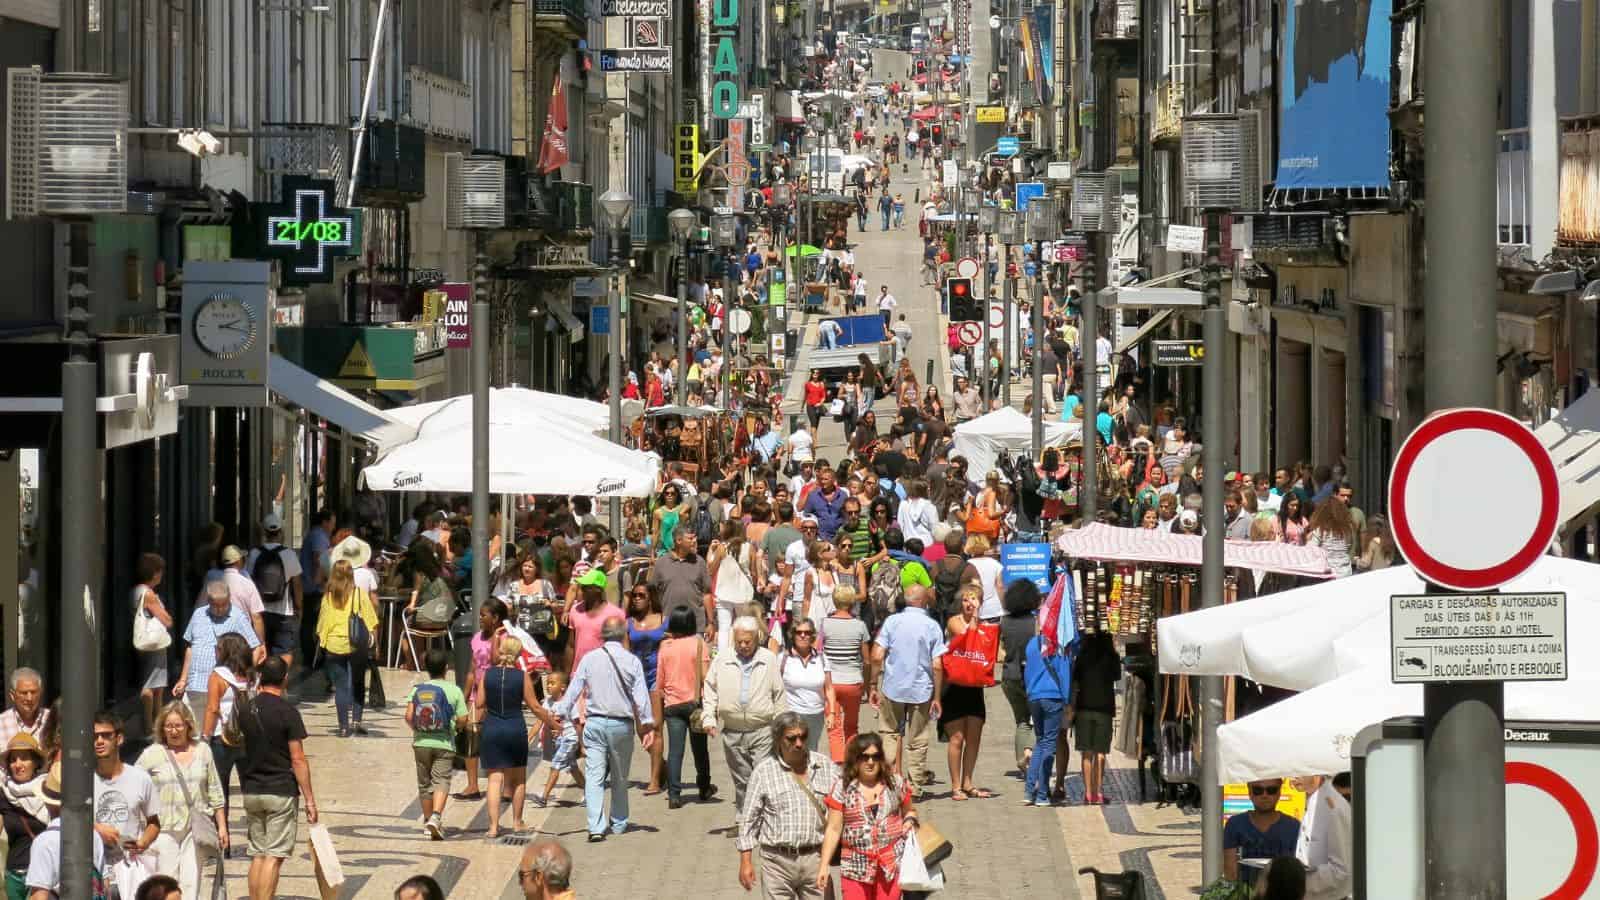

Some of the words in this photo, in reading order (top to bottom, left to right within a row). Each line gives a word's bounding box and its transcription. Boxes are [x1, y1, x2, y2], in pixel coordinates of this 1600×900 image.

[277, 222, 341, 241] 21/08
[201, 368, 246, 379] ROLEX
[393, 473, 423, 489] Sumol
[596, 479, 626, 494] Sumol
[1400, 599, 1433, 609] CARGAS
[1438, 599, 1443, 609] E
[1448, 598, 1497, 609] DESCARGAS
[1502, 596, 1558, 607] AUTORIZADAS
[1425, 612, 1443, 622] DIAS
[1475, 611, 1492, 622] DAS
[1520, 610, 1534, 621] 11H
[1416, 625, 1459, 636] PERMITIDO
[1464, 625, 1496, 635] ACESSO
[1501, 624, 1512, 635] AO
[1516, 623, 1543, 634] HOTEL
[1434, 642, 1495, 656] TRANSGRESSÃO
[1498, 643, 1528, 654] SUJEITA
[1531, 643, 1536, 653] A
[1538, 643, 1562, 653] COIMA
[1434, 663, 1508, 677] BLOQUEAMENTO
[1511, 663, 1516, 675] E
[1519, 662, 1562, 674] REBOQUE
[1504, 728, 1550, 741] Decaux
